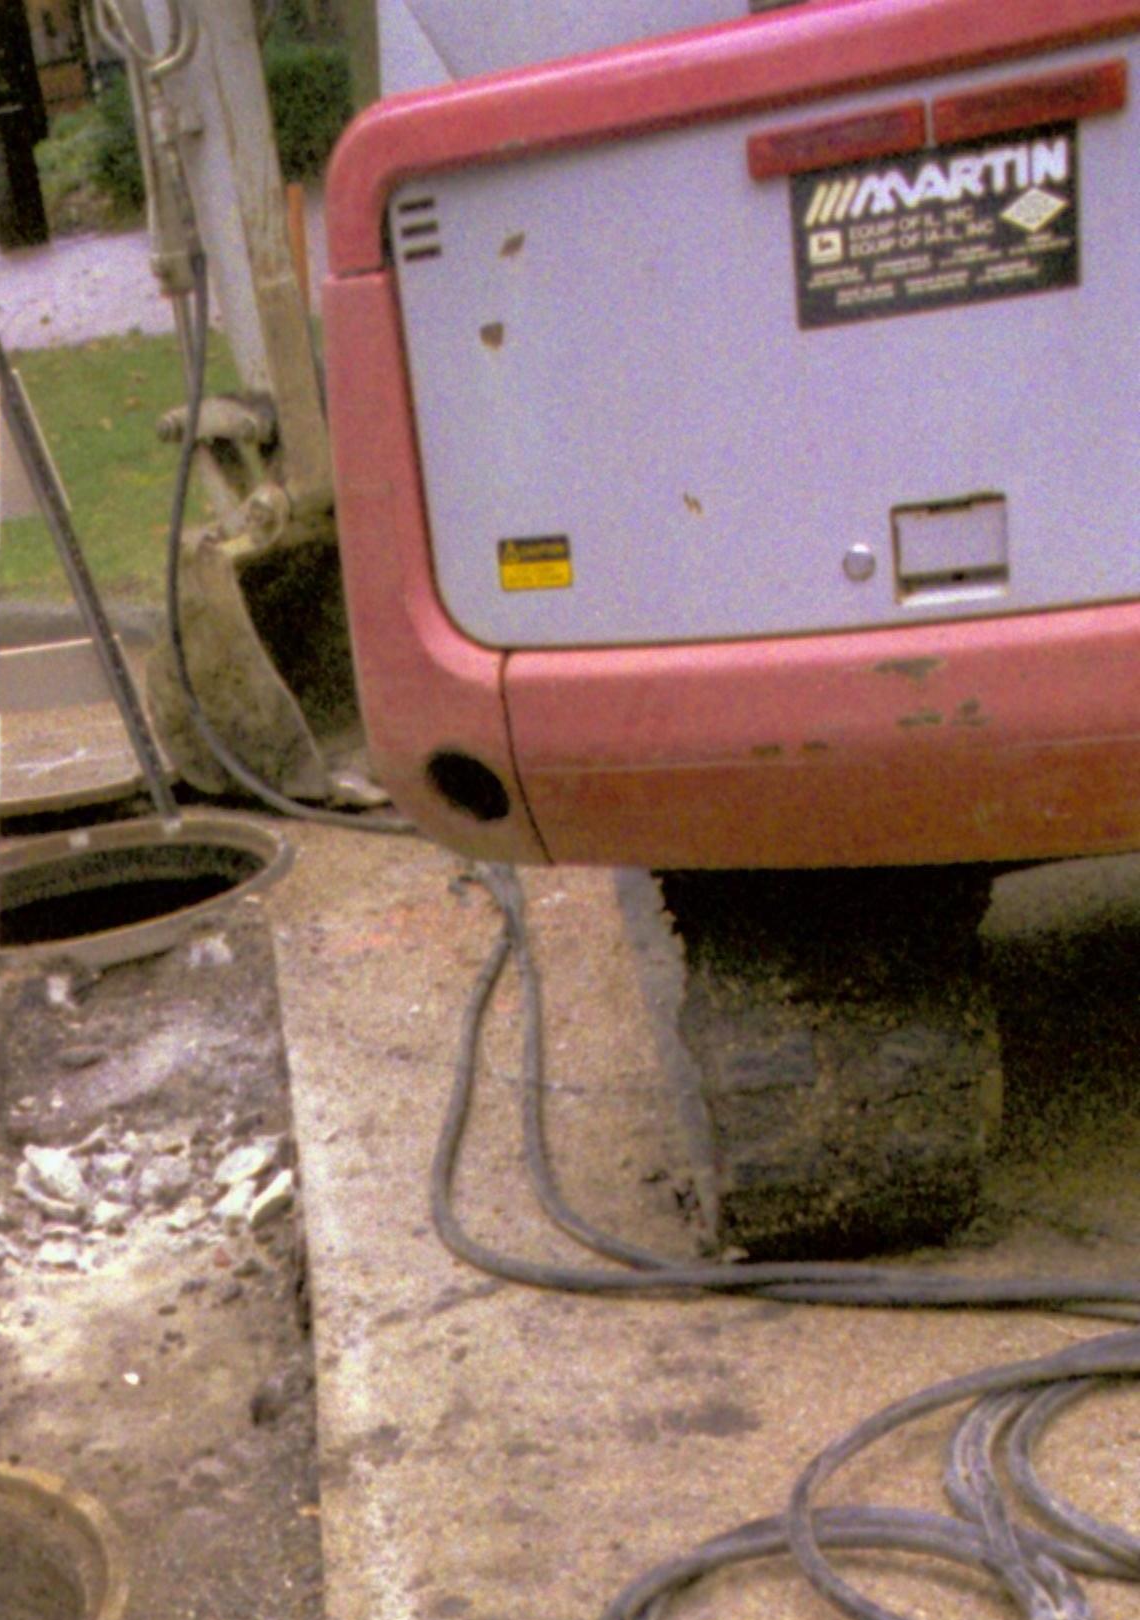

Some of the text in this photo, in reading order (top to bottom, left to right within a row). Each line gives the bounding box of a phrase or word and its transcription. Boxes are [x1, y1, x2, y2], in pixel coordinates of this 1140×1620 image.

[850, 137, 1067, 218] MARTIN
[898, 213, 921, 230] OF
[898, 232, 921, 248] OF
